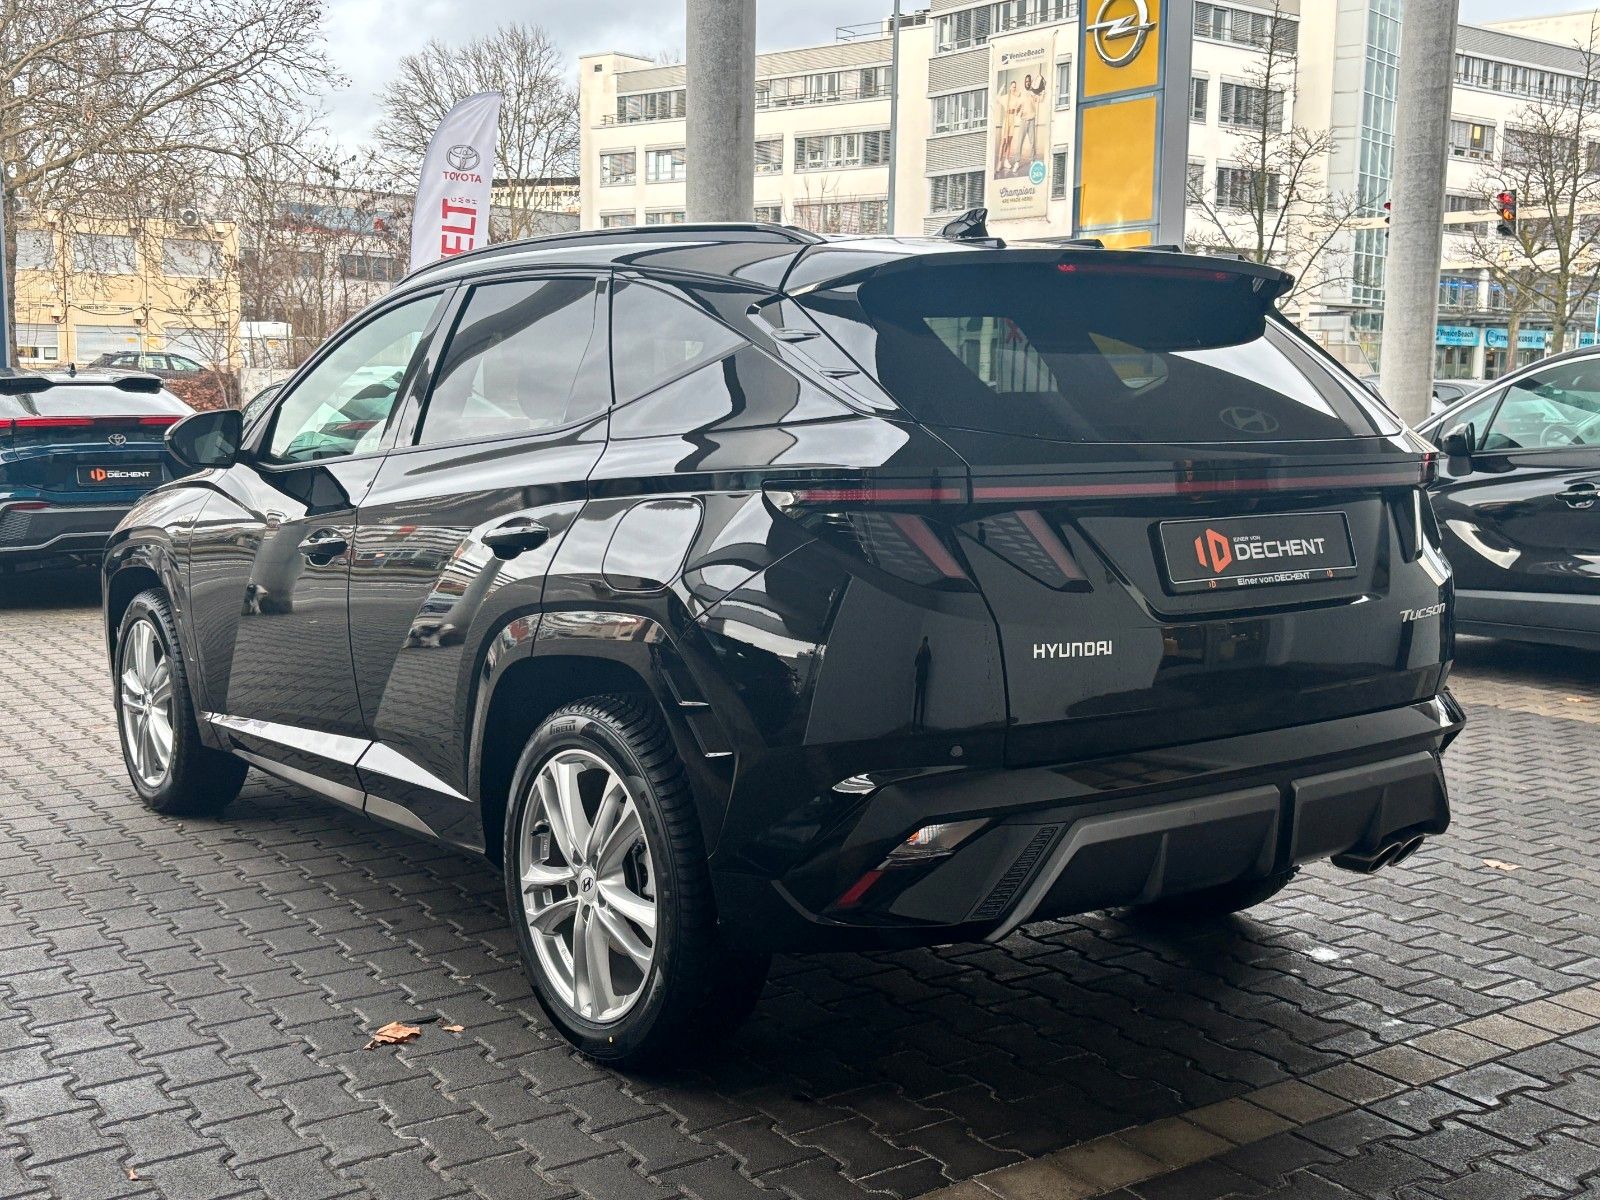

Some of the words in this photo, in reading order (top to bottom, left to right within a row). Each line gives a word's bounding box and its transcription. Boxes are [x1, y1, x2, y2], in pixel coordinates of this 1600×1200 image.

[442, 171, 482, 184] TOYOTA
[1234, 537, 1325, 561] DECHENT
[1237, 577, 1258, 586] Einer
[1259, 575, 1274, 584] von
[1274, 571, 1311, 583] DECHENT
[1033, 640, 1113, 659] HYUNDAI
